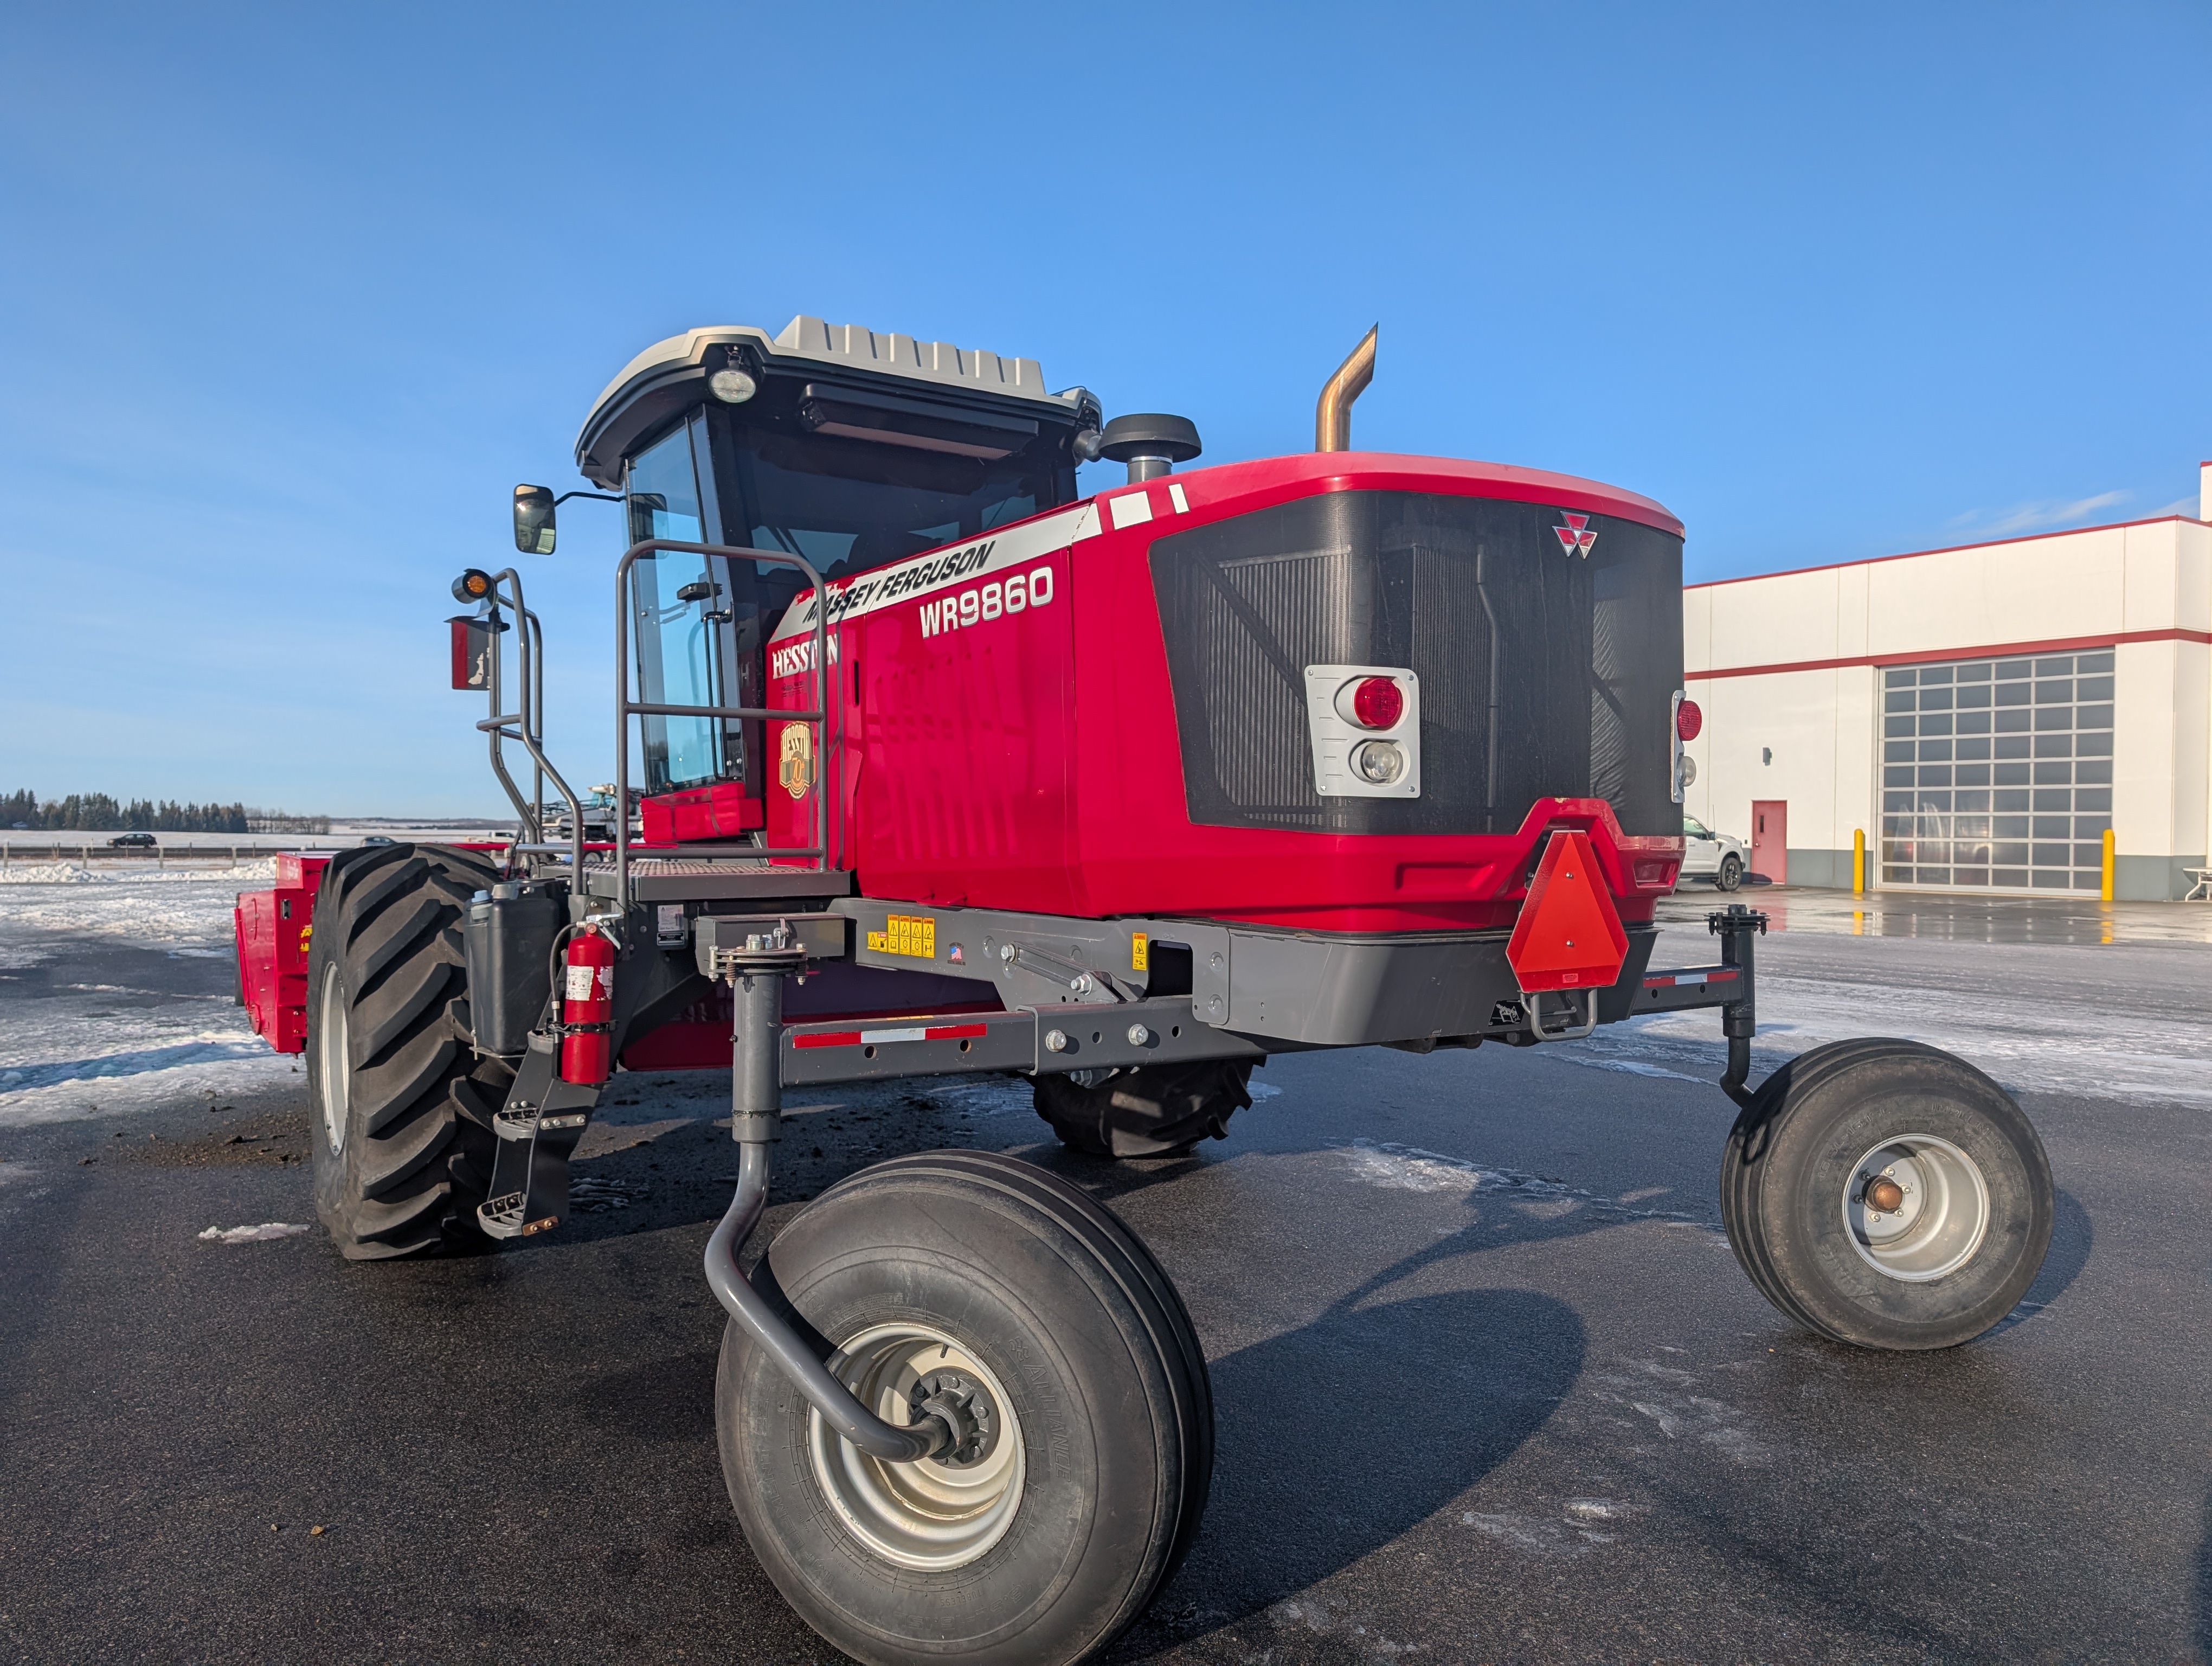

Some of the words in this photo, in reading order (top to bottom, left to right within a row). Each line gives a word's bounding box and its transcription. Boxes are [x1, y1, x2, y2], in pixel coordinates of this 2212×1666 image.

[876, 540, 996, 601] FERGUSON
[919, 566, 1053, 639] WR9860
[773, 633, 840, 680] HESSTN
[1024, 1365, 1072, 1482] ALLIANCE
[939, 1590, 984, 1607] TUBELESS
